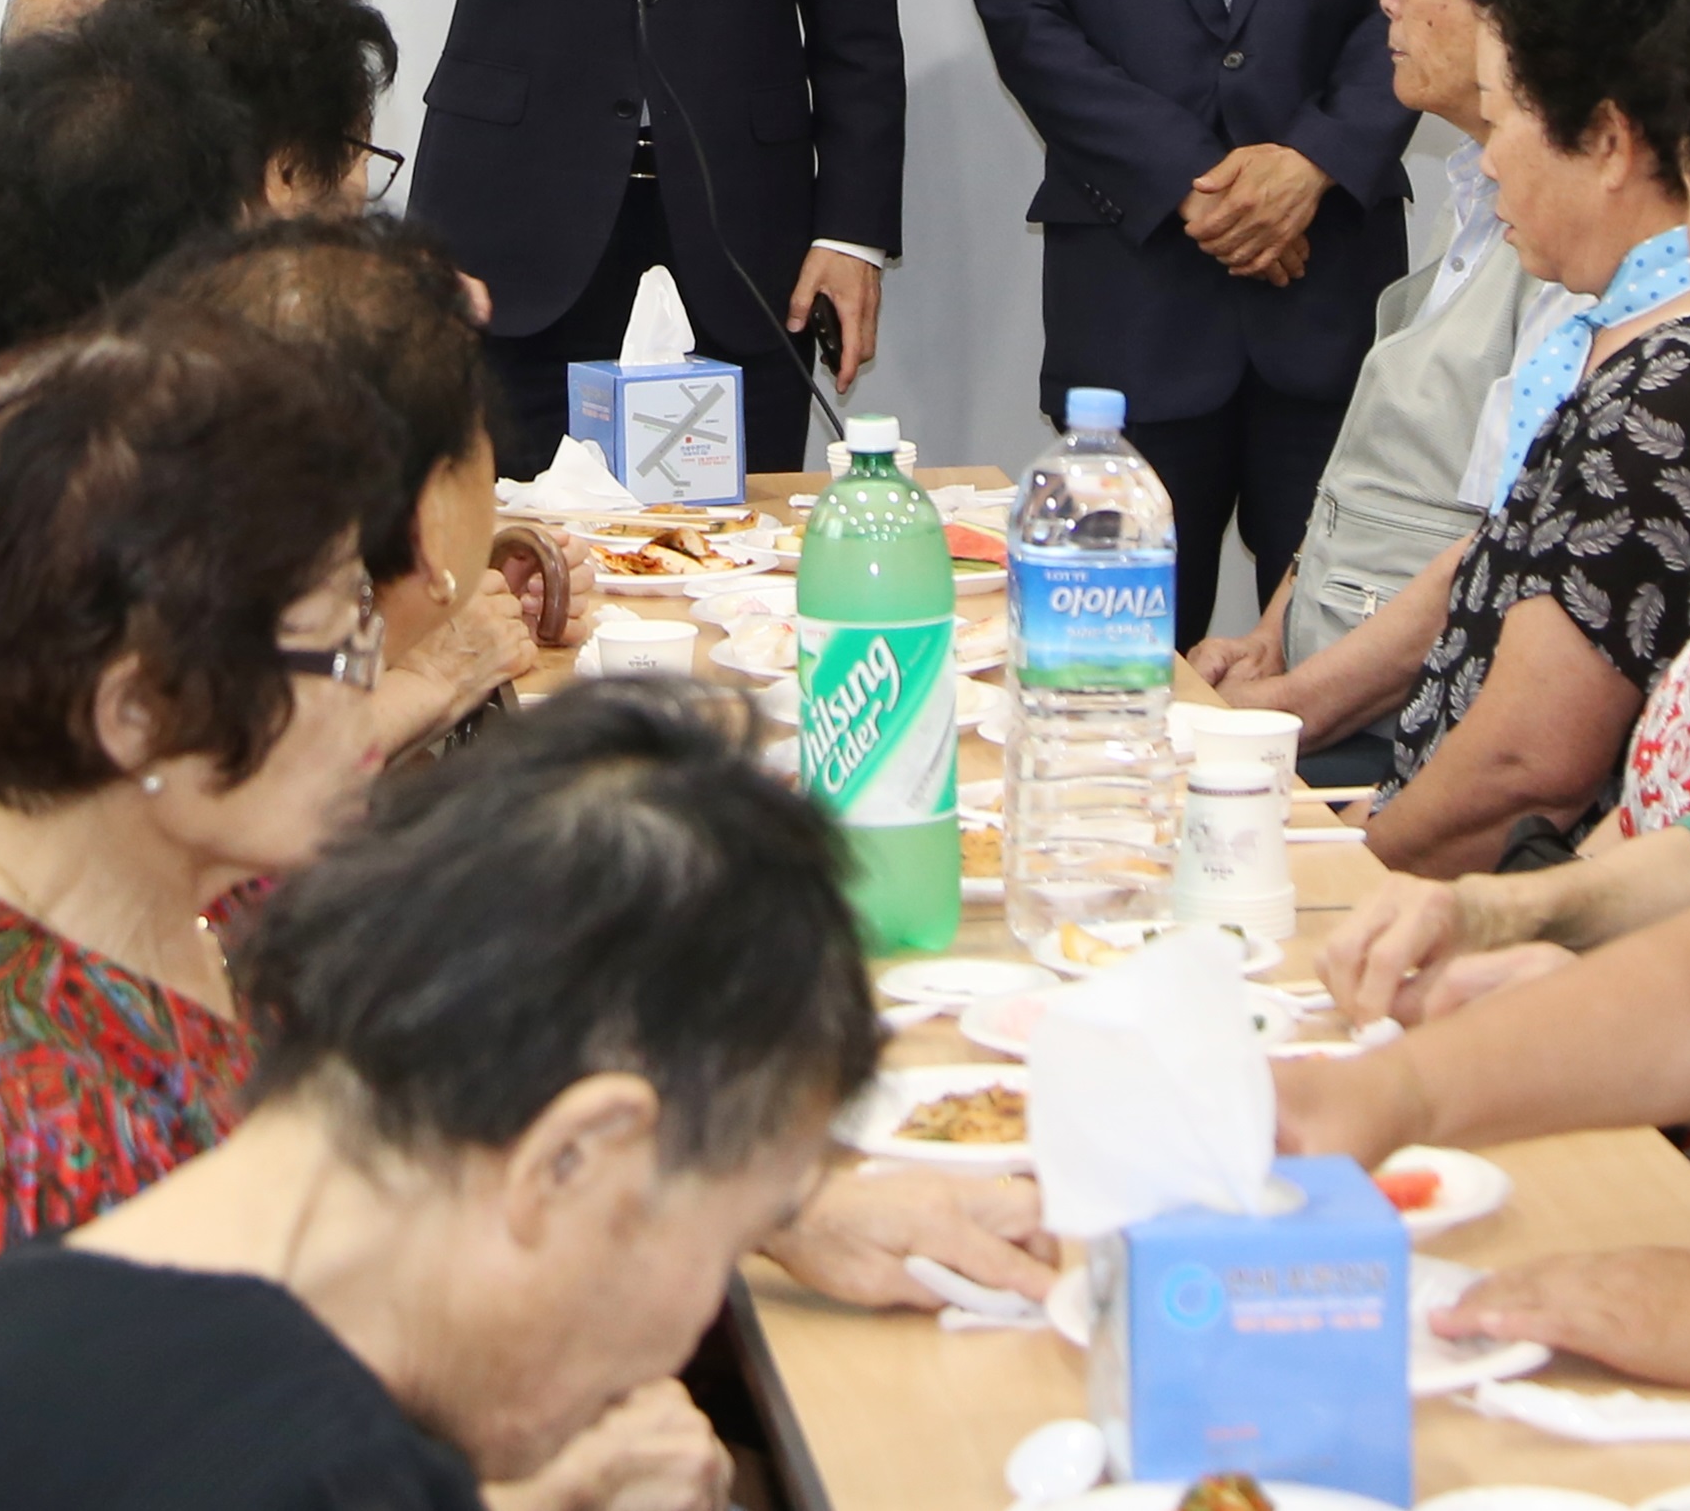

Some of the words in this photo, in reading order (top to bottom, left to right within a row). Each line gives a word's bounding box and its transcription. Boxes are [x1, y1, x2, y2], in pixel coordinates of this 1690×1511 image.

[1050, 585, 1168, 619] 아이시스
[801, 635, 902, 785] hilsung
[822, 699, 884, 795] Cider
